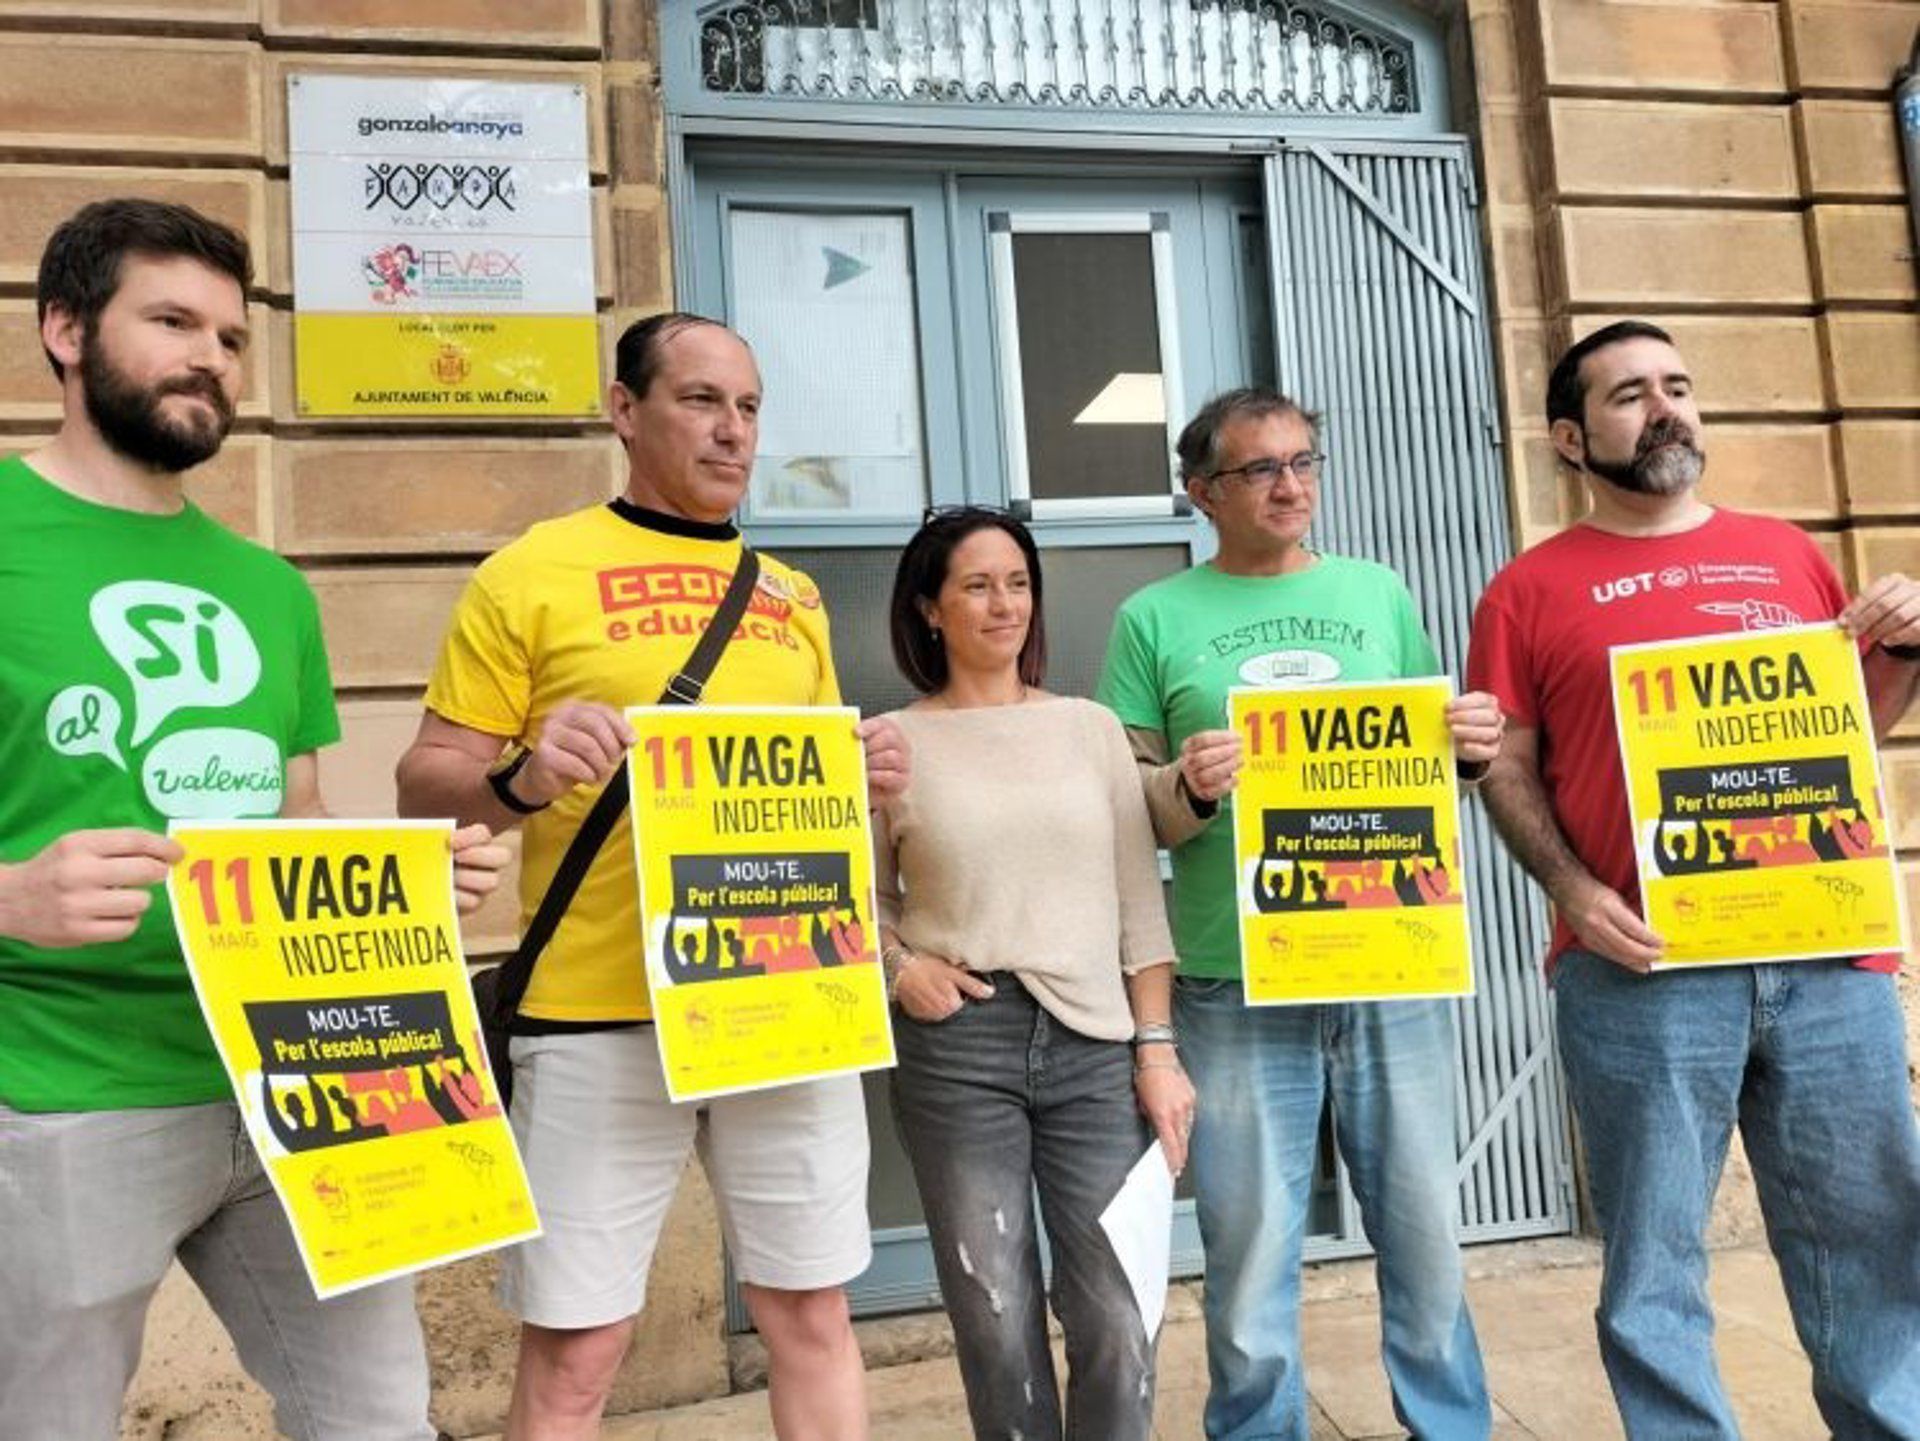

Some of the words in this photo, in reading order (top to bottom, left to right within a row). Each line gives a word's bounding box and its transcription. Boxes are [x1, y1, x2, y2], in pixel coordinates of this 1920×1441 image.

[422, 250, 522, 277] FEVAEX
[353, 390, 450, 403] AJUNTAMENT
[454, 391, 473, 403] DE
[1592, 572, 1654, 603] UGT
[1208, 616, 1365, 657] ESTIMEM
[1628, 667, 1677, 715] 11
[1688, 652, 1816, 708] VAGA
[56, 693, 100, 746] al
[1244, 711, 1287, 756] 11
[1300, 705, 1412, 752] VAGA
[1695, 703, 1860, 748] INDEFINIDA
[644, 735, 696, 789] 11
[708, 734, 826, 788] VAGA
[1302, 757, 1445, 792] INDEFINIDA
[1711, 766, 1798, 789] MOU-TE.
[713, 795, 861, 834] INDEFINIDA
[1674, 795, 1703, 813] Per
[1706, 790, 1770, 811] l'escola
[1773, 784, 1839, 810] pública!
[1310, 813, 1388, 832] MOU-TE.
[1276, 835, 1301, 851] Per
[1305, 834, 1361, 851] l'escola
[1364, 832, 1422, 853] pública!
[723, 860, 806, 881] MOU-TE.
[189, 858, 255, 925] 11
[268, 853, 410, 922] VAGA
[687, 887, 716, 908] Per
[718, 885, 777, 906] l'escola
[780, 882, 839, 907] pública!
[279, 923, 454, 977] INDEFINIDA
[306, 1005, 400, 1032] MOU-TE.
[273, 1038, 306, 1063] Per
[308, 1034, 377, 1061] l'escola
[378, 1027, 444, 1060] pública!
